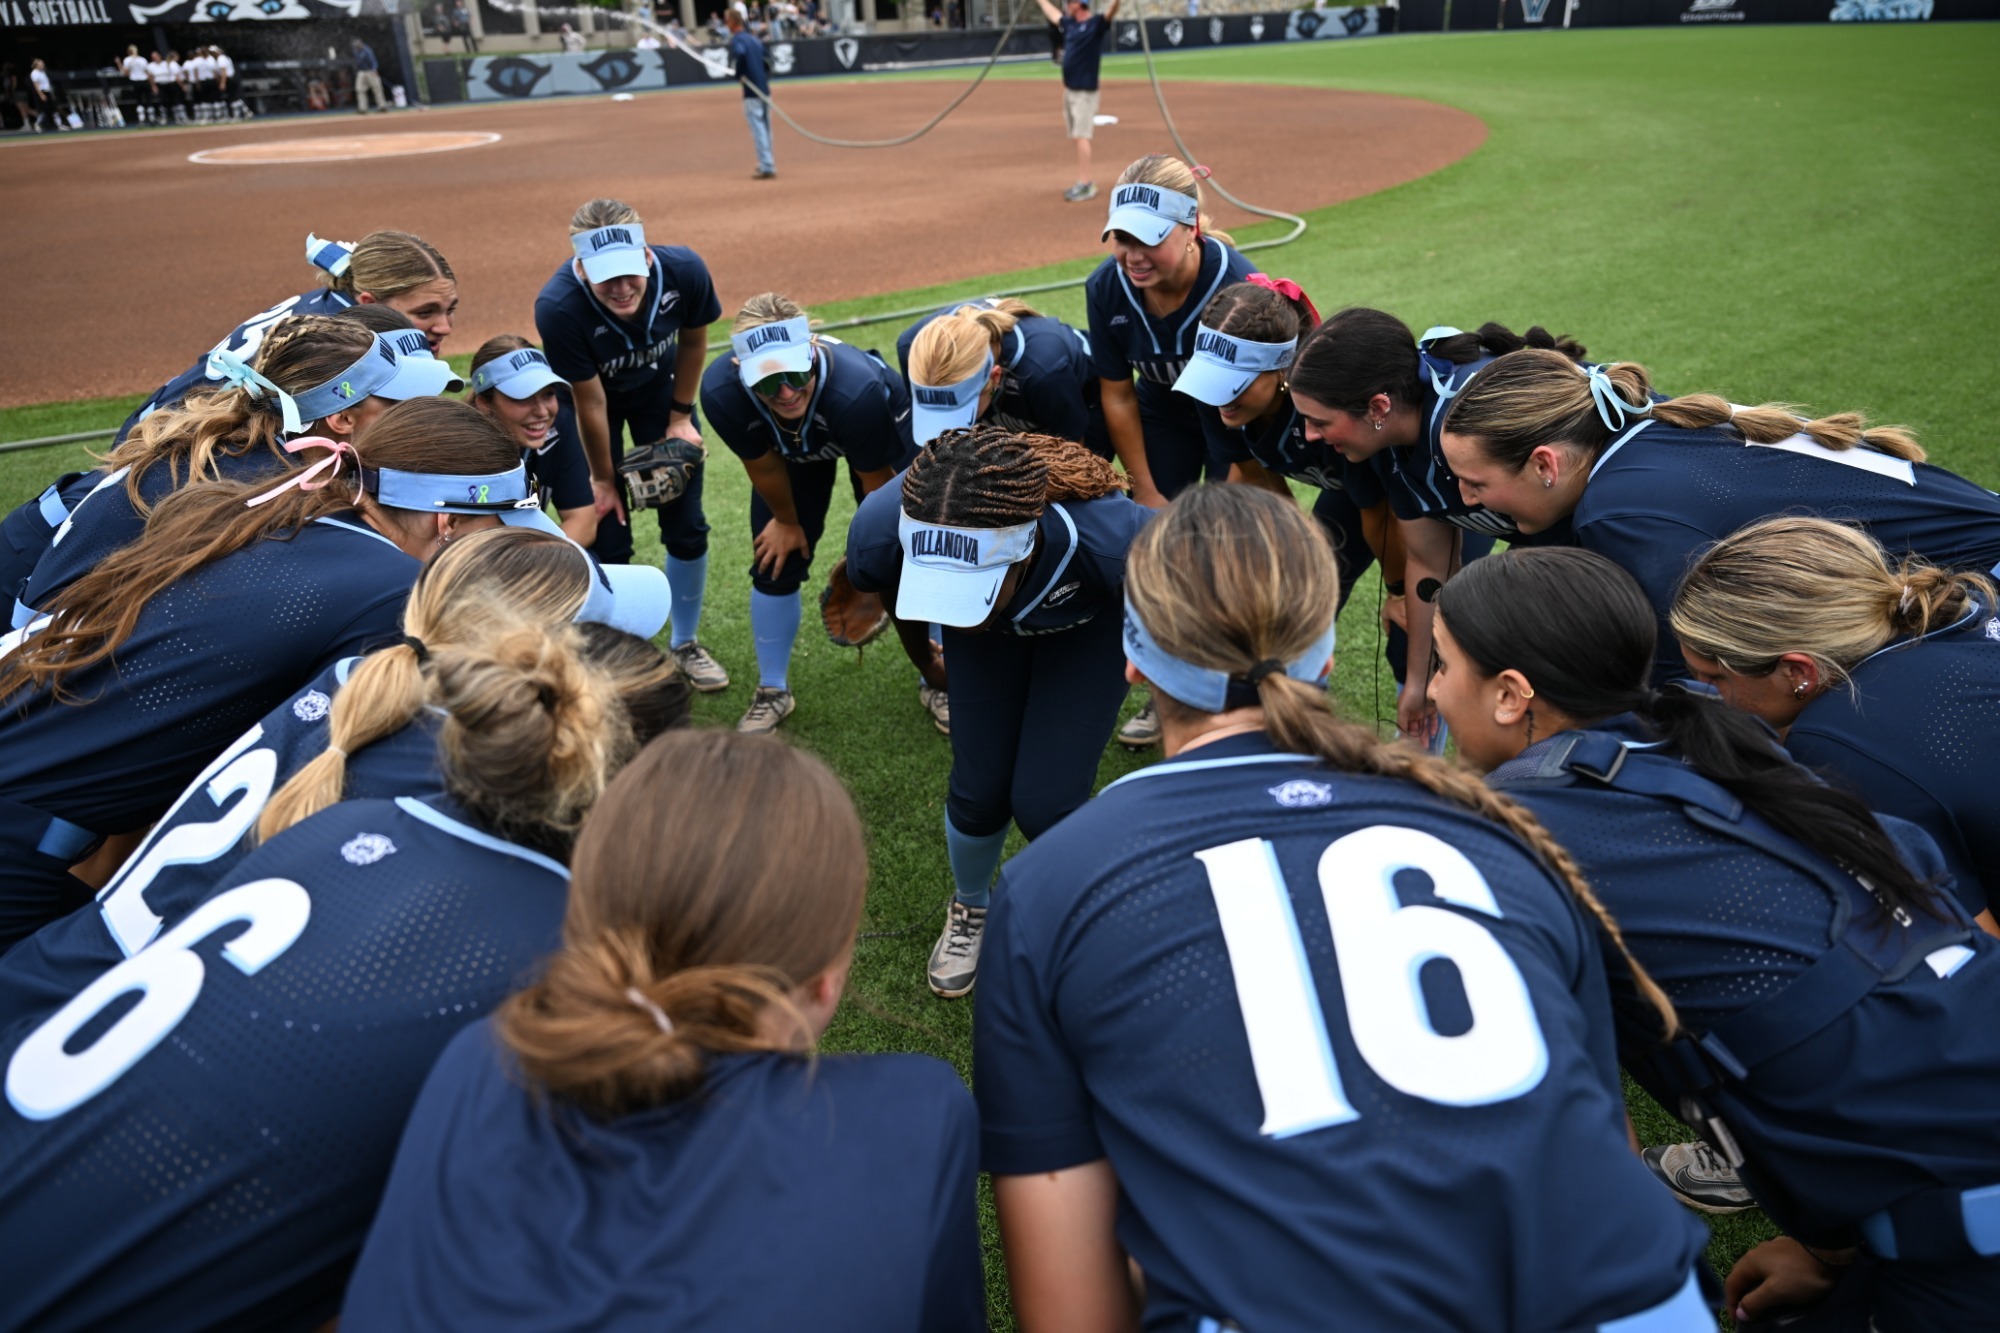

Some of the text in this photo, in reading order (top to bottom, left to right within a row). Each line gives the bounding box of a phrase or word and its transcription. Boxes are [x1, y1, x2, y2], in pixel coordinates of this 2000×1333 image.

[28, 0, 112, 25] SOFTBALL
[1116, 186, 1160, 211] VILLANOVA
[590, 228, 633, 252] VILLANOVA
[746, 326, 791, 352] VILLANOVA
[911, 530, 979, 566] VILLANOVA
[1193, 824, 1549, 1139] 16
[5, 877, 312, 1121] 6
